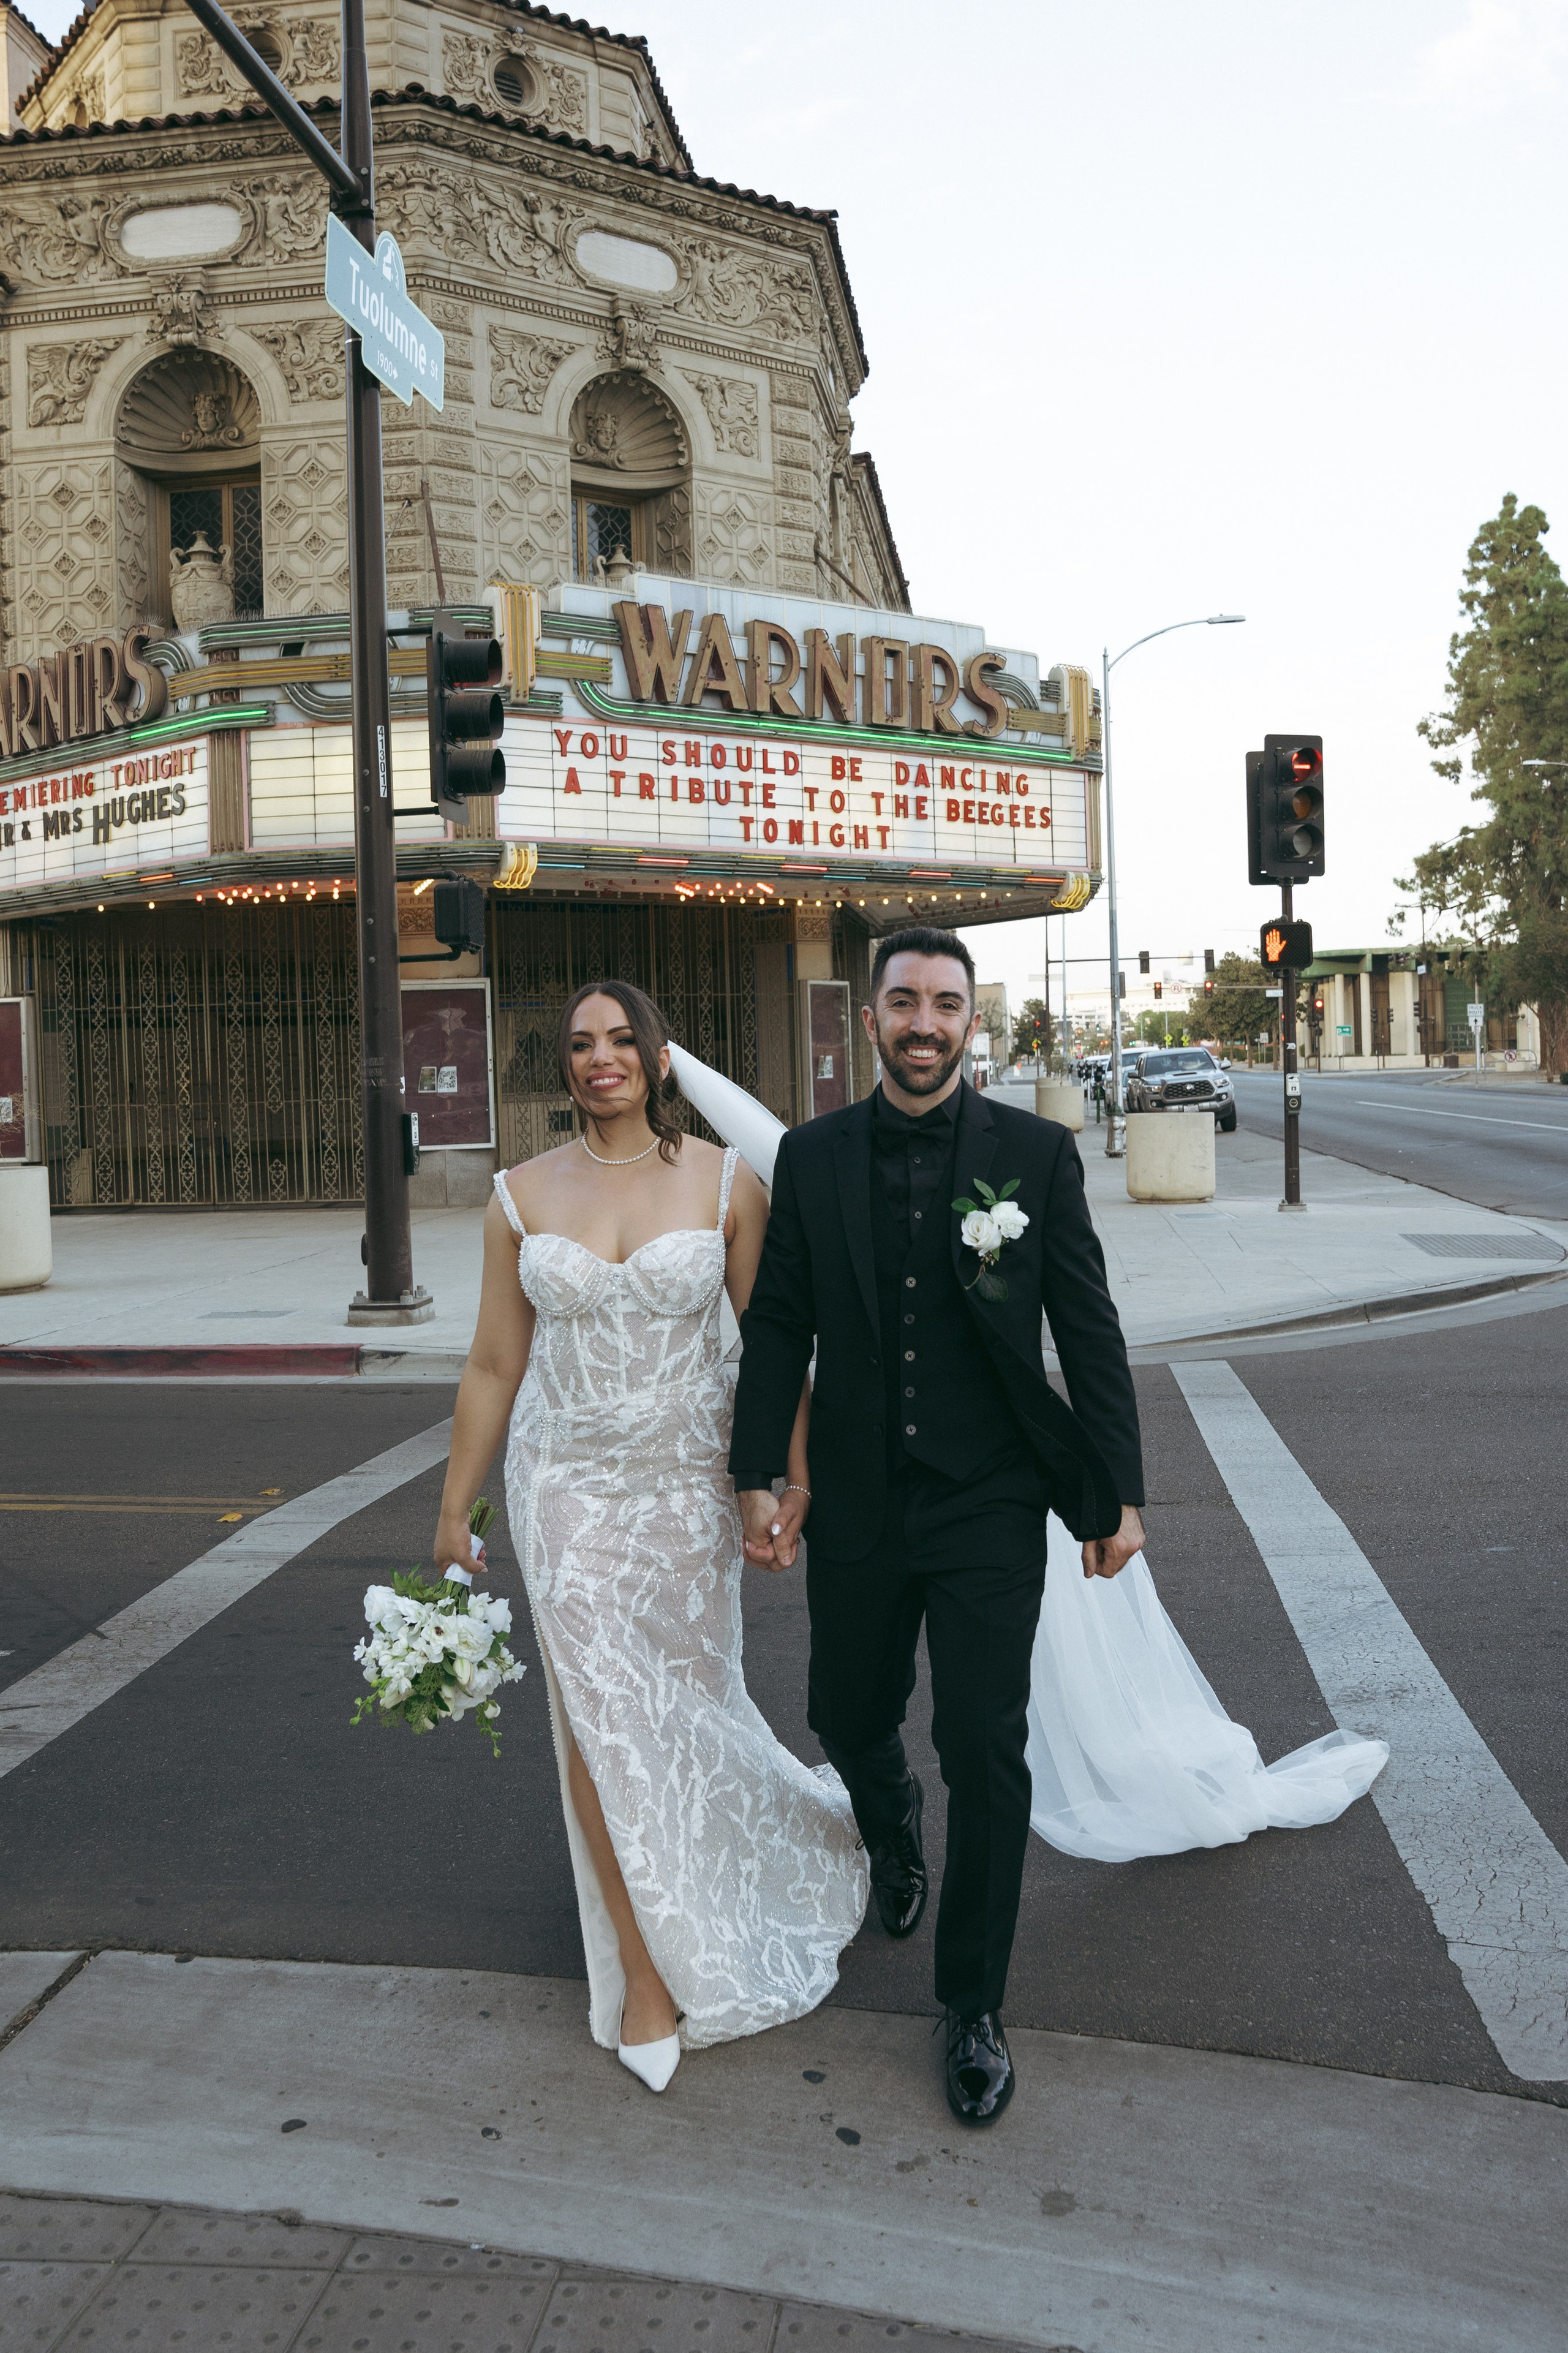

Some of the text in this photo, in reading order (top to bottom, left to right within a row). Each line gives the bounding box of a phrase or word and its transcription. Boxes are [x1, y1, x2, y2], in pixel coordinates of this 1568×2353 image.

[349, 257, 438, 381] Tuolumne St
[377, 350, 393, 379] 1900
[612, 600, 1009, 738] WARNORS
[110, 747, 196, 790] TONIGHT
[378, 726, 387, 796] 413017
[554, 729, 1029, 797] YOU SHOULD BE DANCING
[0, 783, 186, 852] R & MRS HUGHES
[564, 767, 1051, 829] A TRIBUTE TO THE BEEGEES
[740, 815, 891, 850] TONIGHT
